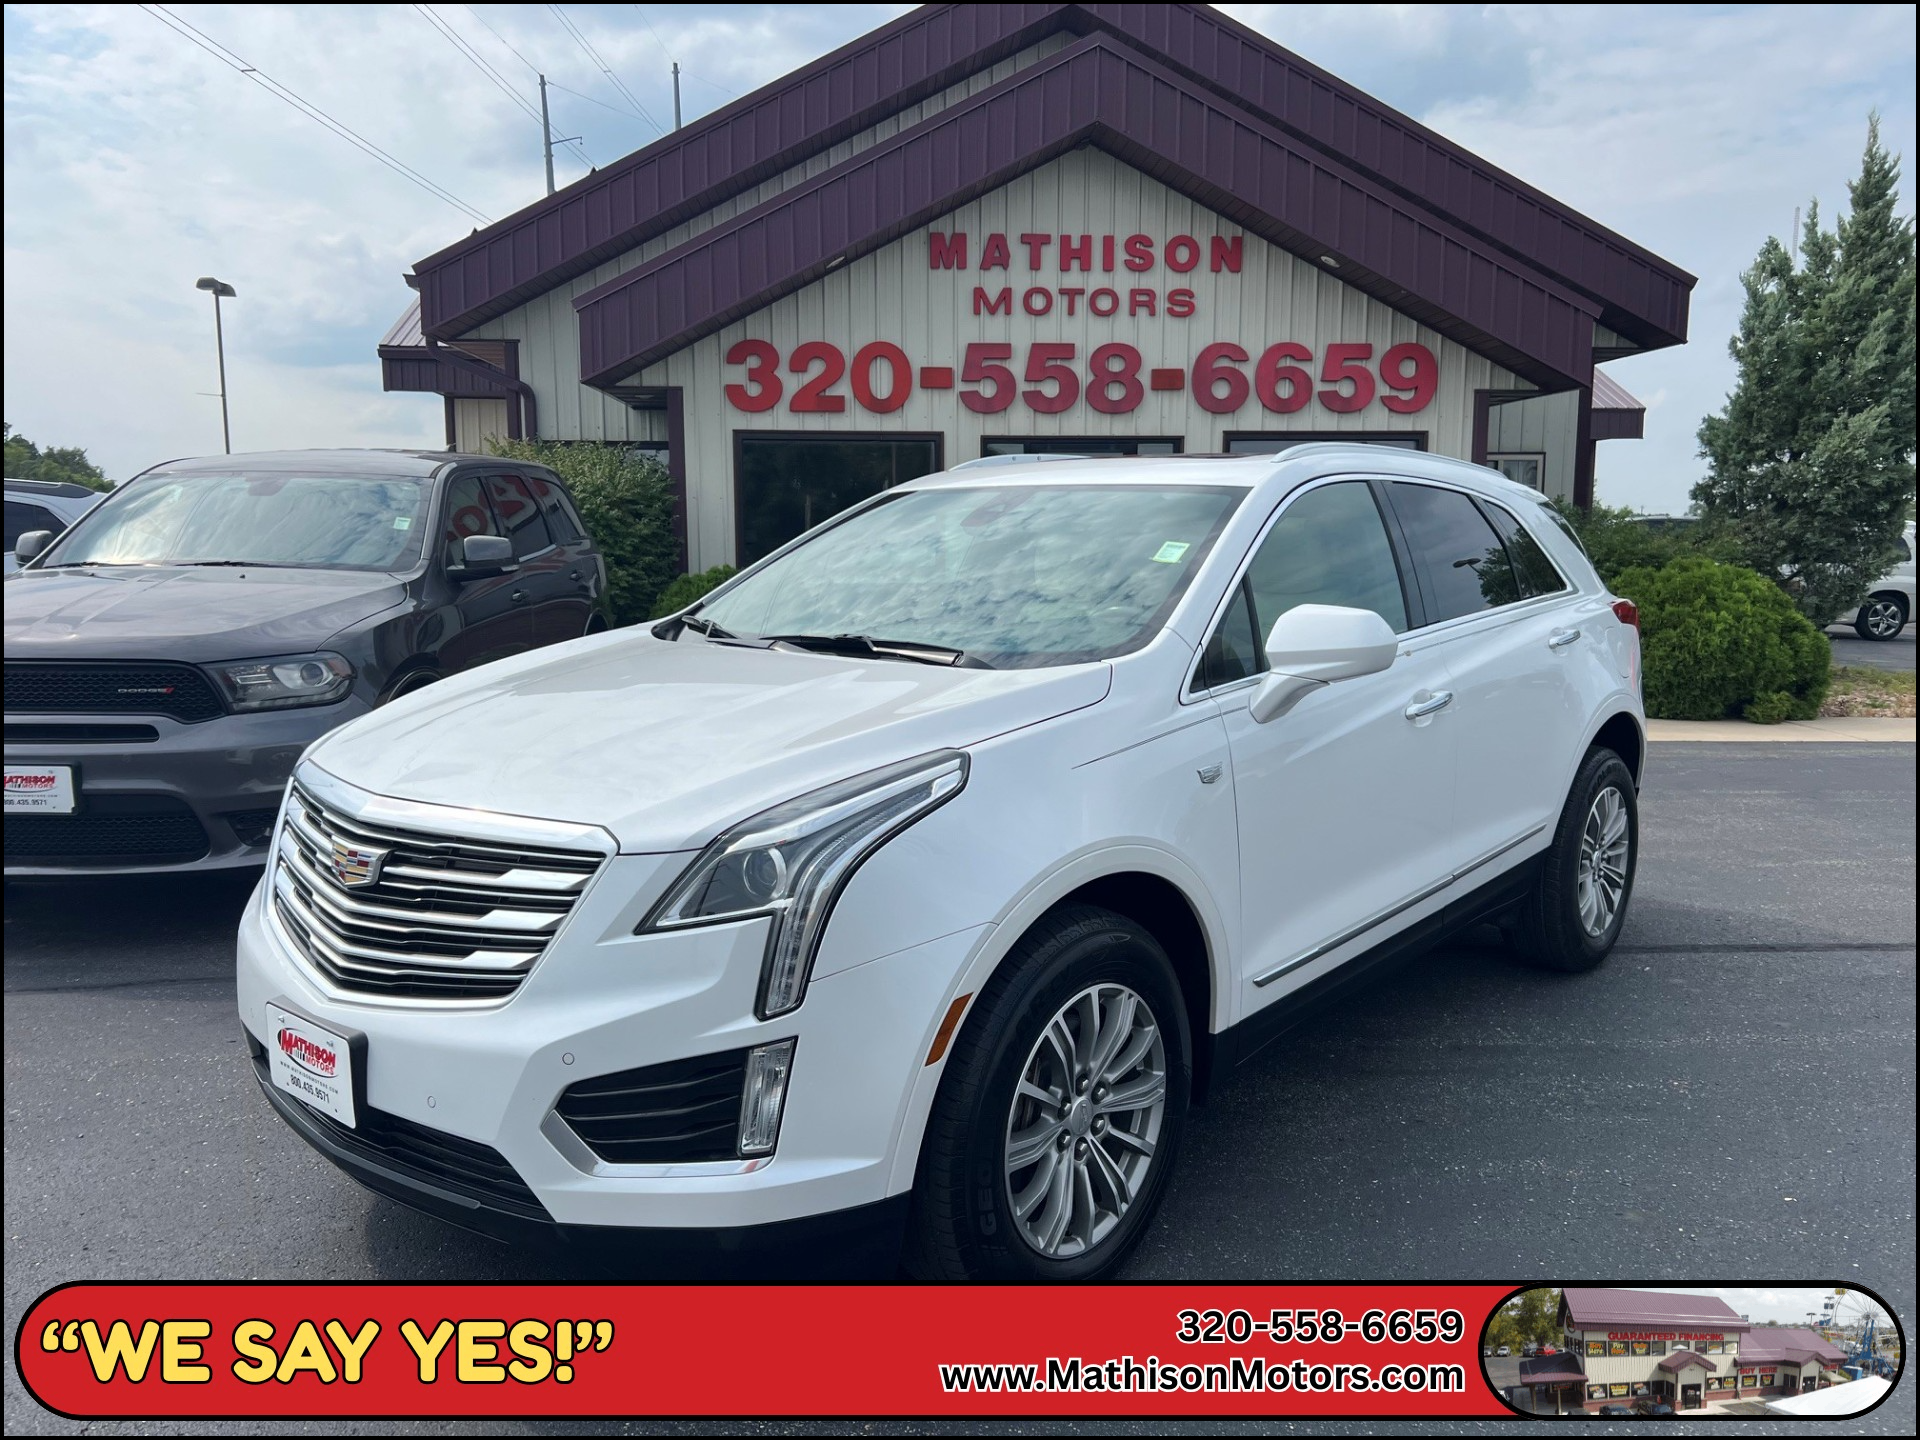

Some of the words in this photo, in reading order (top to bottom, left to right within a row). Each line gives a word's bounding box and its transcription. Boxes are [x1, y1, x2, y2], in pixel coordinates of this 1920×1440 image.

[929, 232, 1243, 272] MATHISON
[973, 286, 1196, 317] MOTORS
[724, 339, 1438, 414] 320-558-6659
[280, 1029, 336, 1067] MATHISON
[305, 1054, 335, 1075] MOTORS
